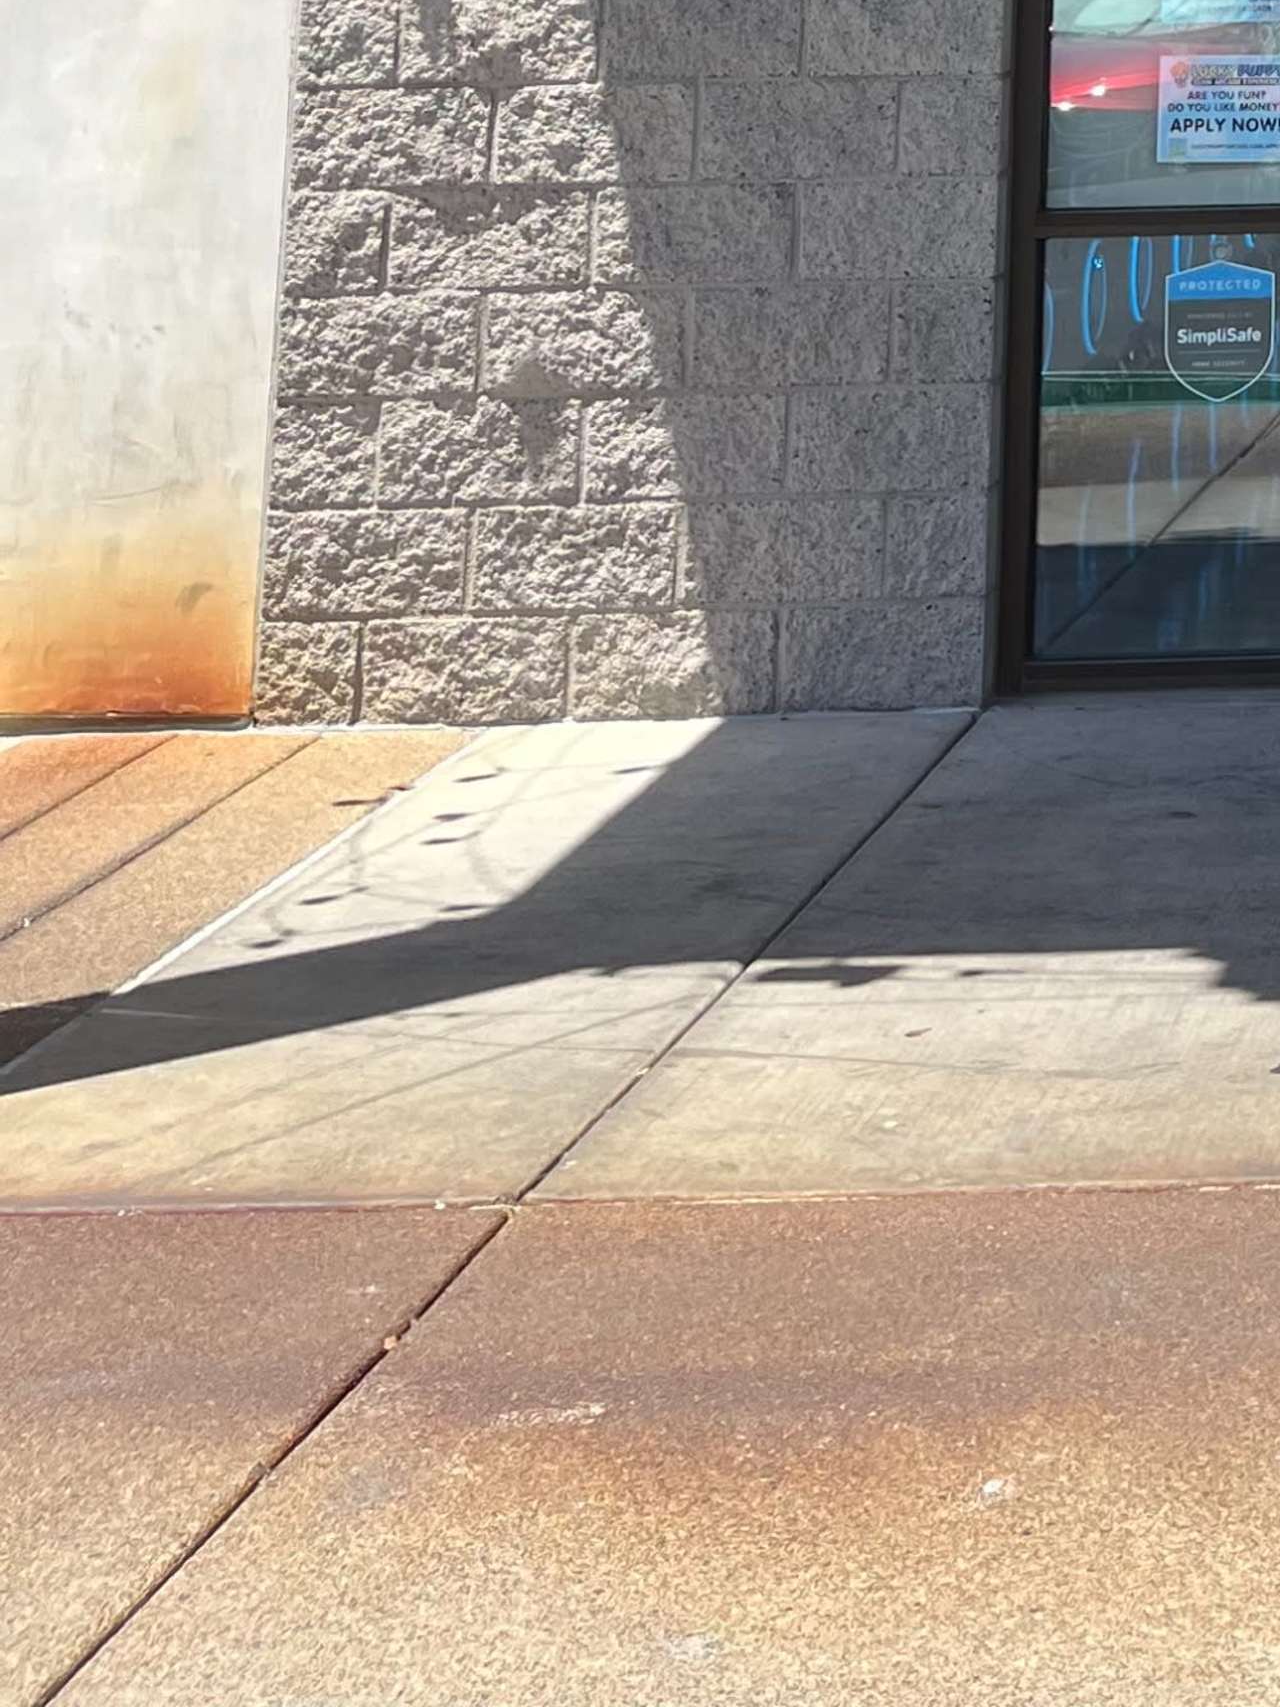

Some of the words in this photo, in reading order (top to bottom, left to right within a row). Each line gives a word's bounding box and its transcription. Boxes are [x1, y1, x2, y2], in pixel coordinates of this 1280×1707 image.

[1187, 91, 1207, 100] ARE
[1211, 91, 1234, 100] YOU
[1238, 90, 1267, 99] FUN?
[1167, 103, 1184, 112] DO
[1187, 103, 1210, 112] YOU
[1214, 103, 1236, 112] LIKE
[1170, 118, 1226, 133] APPLY
[1179, 279, 1261, 292] PROTECTED
[1177, 327, 1262, 346] SimpliSafe
